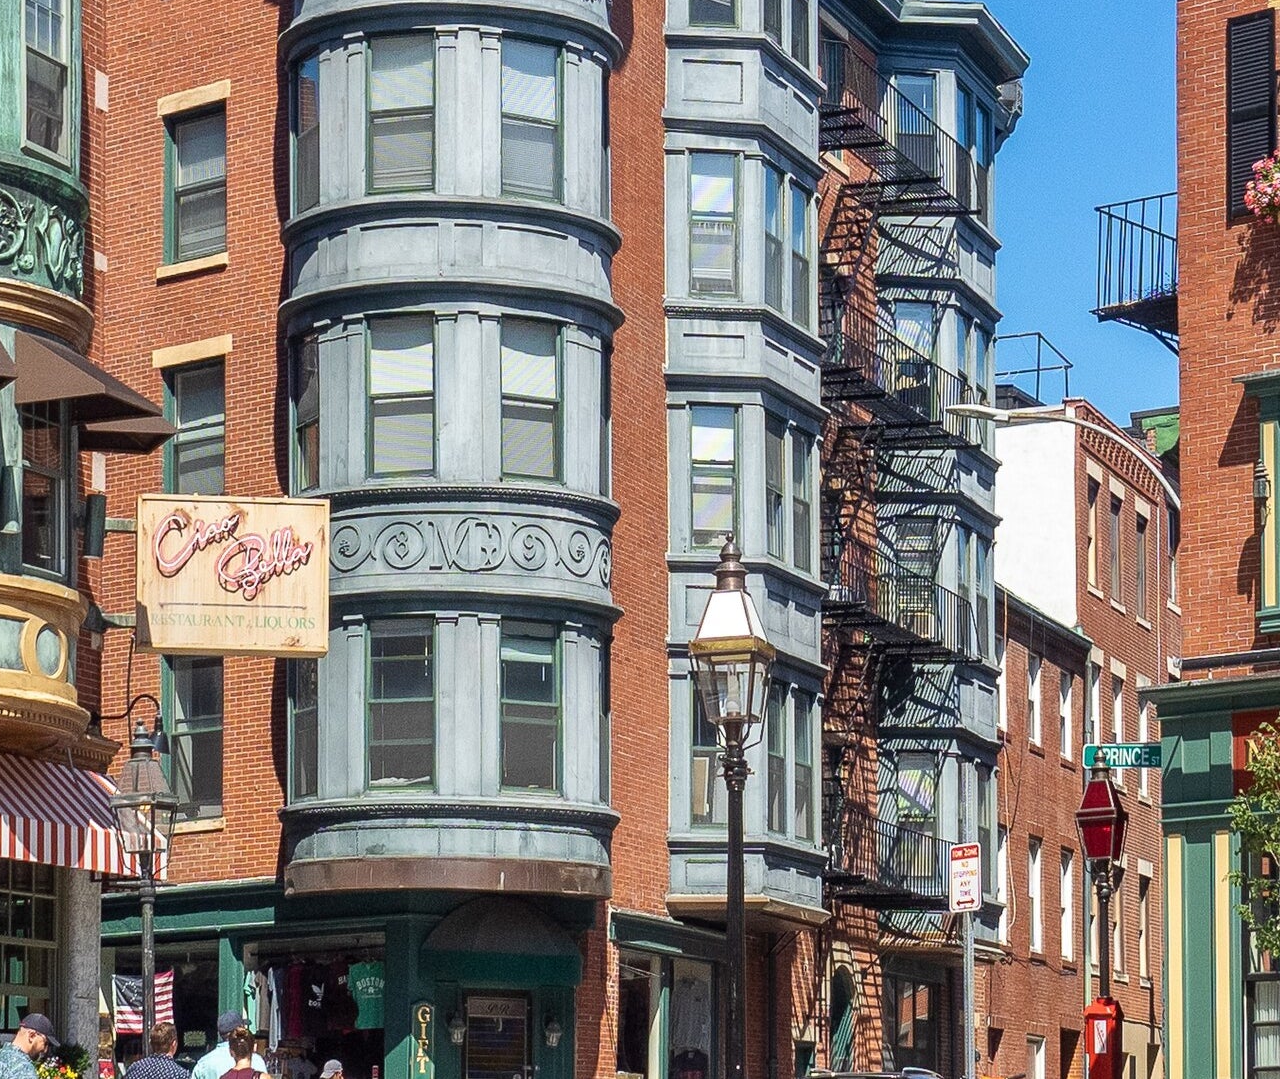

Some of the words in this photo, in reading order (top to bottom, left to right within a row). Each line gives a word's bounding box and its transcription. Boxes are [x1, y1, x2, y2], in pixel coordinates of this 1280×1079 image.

[153, 514, 241, 578] Ciao
[215, 528, 314, 601] Bella
[151, 612, 245, 629] RESTAURANT
[255, 615, 317, 630] LIQUORS
[1102, 747, 1150, 766] PRINCE
[356, 976, 385, 991] BOSTON
[417, 1005, 430, 1074] GIFT
